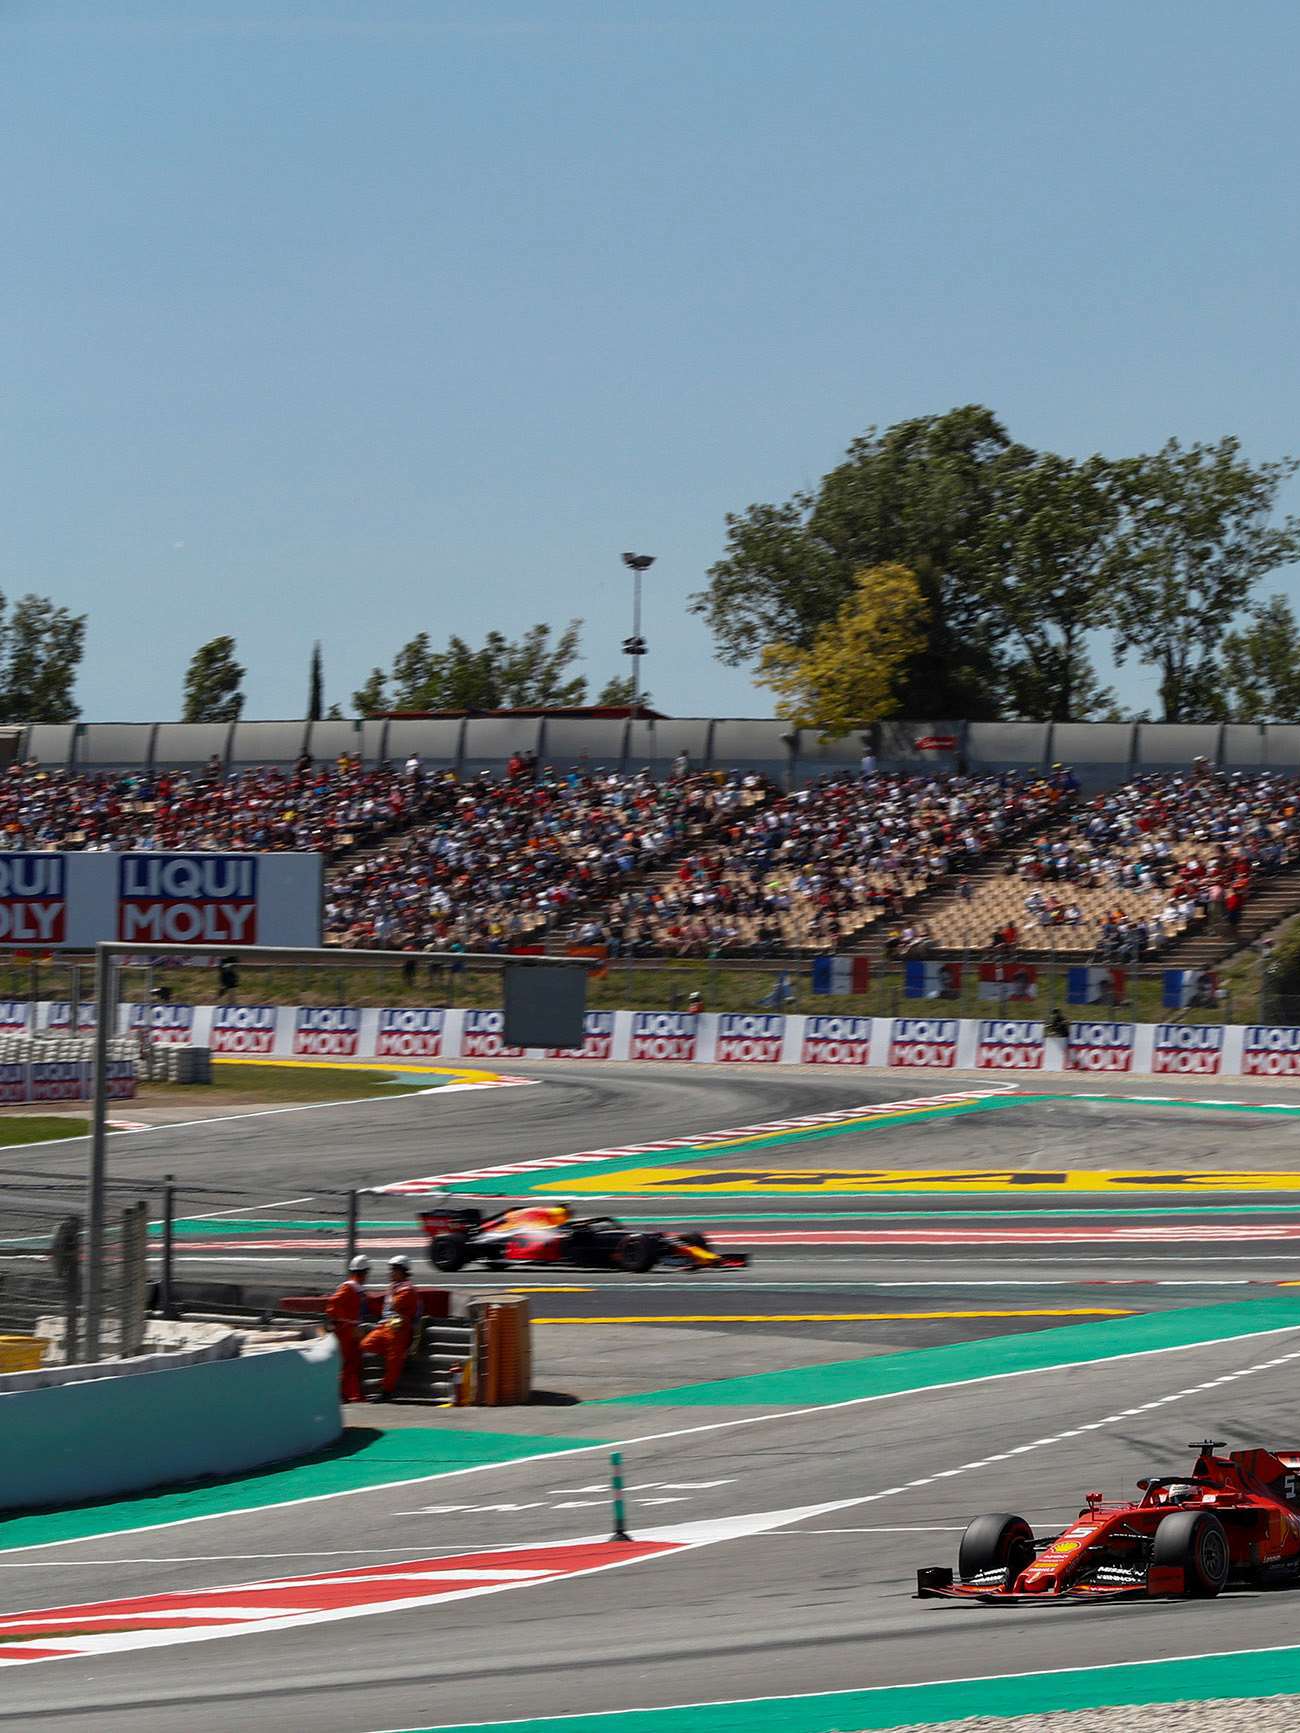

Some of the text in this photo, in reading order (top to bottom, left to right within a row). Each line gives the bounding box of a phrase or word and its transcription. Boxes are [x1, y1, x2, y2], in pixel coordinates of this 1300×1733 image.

[123, 858, 251, 898] LIQUI
[0, 902, 64, 940] LY
[123, 904, 256, 941] MOLY
[216, 1007, 273, 1028] LIQUI
[298, 1008, 359, 1030] LIQUI
[380, 1010, 442, 1031] LIQUI
[635, 1013, 696, 1035] LIQUI
[721, 1015, 784, 1037] LIQUI
[807, 1018, 871, 1039] LIQUI
[896, 1020, 958, 1041] LIQUI
[981, 1022, 1044, 1043] LIQUI
[1070, 1023, 1134, 1045] LIQUI
[1157, 1026, 1221, 1048] LIQUI
[212, 1031, 273, 1052] MOLY
[296, 1032, 357, 1054] MOLY
[378, 1034, 440, 1056] MOLY
[632, 1038, 696, 1059] MOLY
[718, 1040, 782, 1061] MOLY
[804, 1042, 869, 1063] MOLY
[893, 1045, 956, 1066] MOLY
[980, 1047, 1043, 1068] MOLY
[1067, 1049, 1133, 1070] MOLY
[1154, 1051, 1221, 1073] MOLY
[1284, 1475, 1296, 1499] 5
[1064, 1526, 1098, 1539] 5
